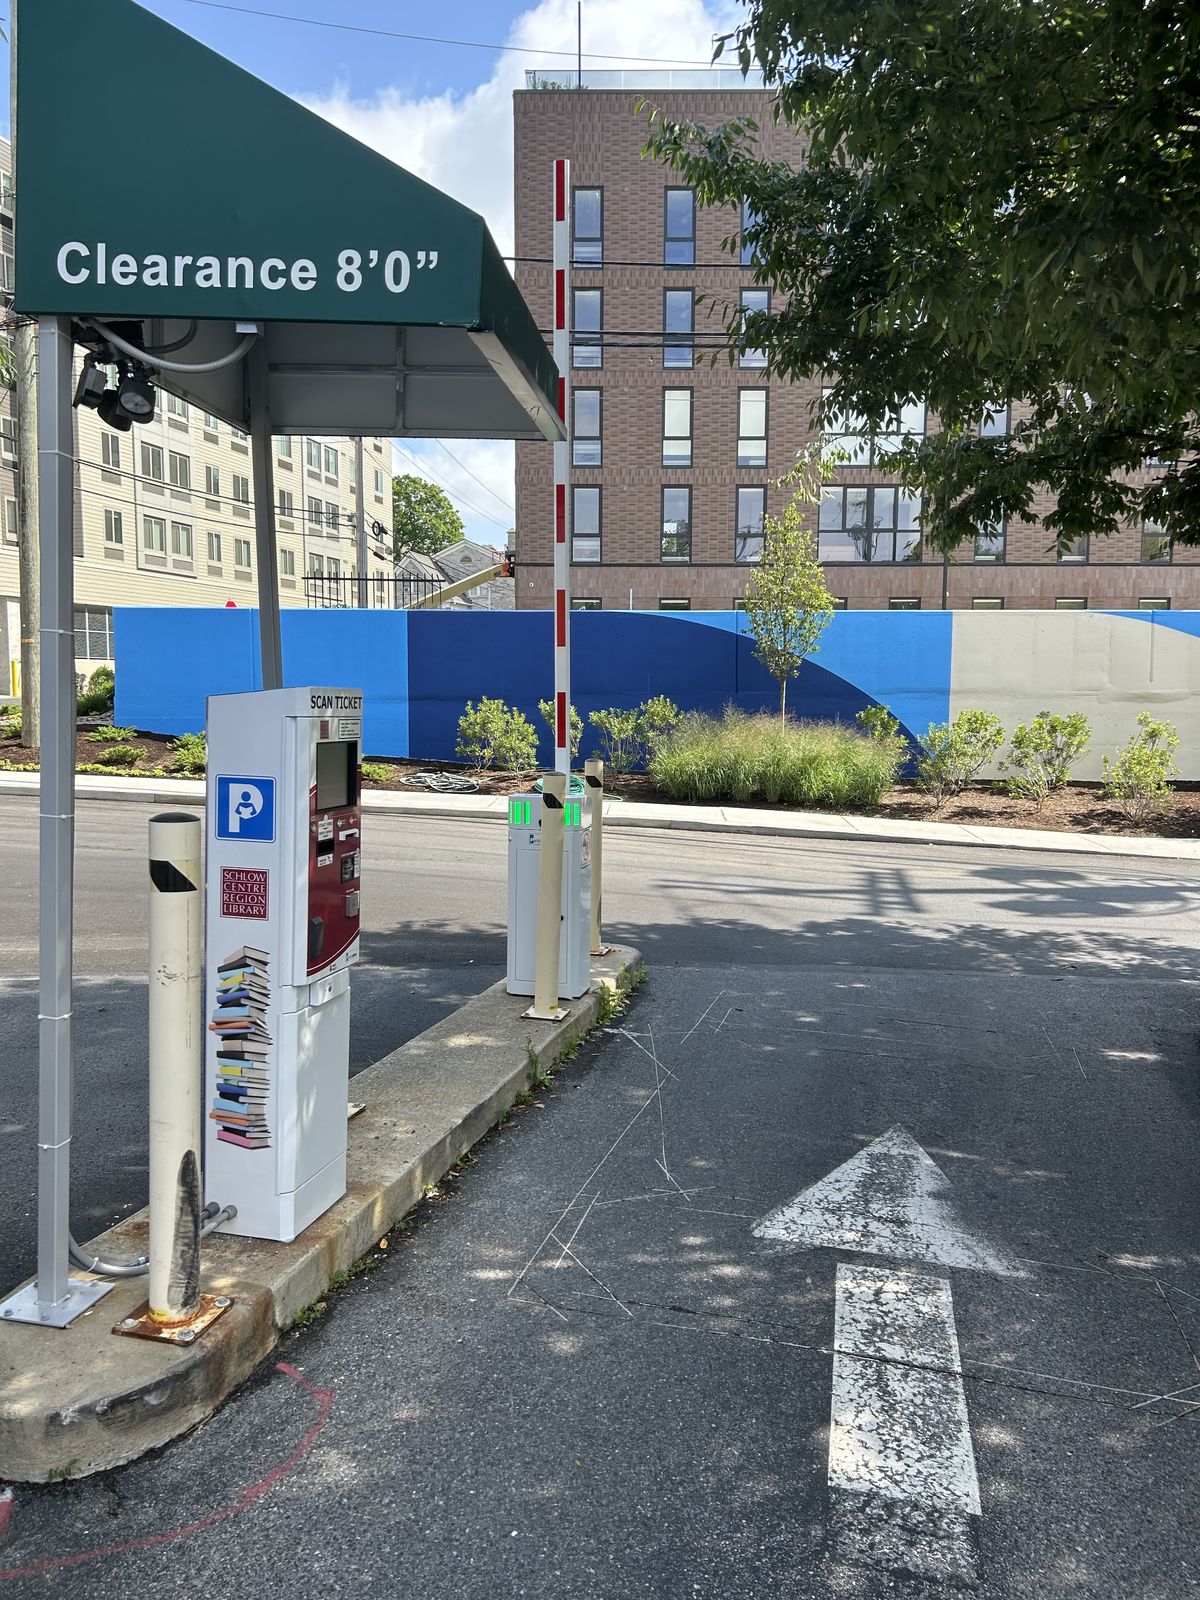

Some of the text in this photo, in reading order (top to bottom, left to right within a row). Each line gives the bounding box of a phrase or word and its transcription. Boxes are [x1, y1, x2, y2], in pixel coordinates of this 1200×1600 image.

[57, 241, 317, 290] Clearance
[311, 695, 362, 709] SCAN TICKET
[229, 783, 263, 832] P
[224, 871, 266, 882] SCHLOW
[224, 882, 266, 893] CENTRE
[224, 893, 266, 904] REGION
[224, 904, 266, 915] LIBRARY
